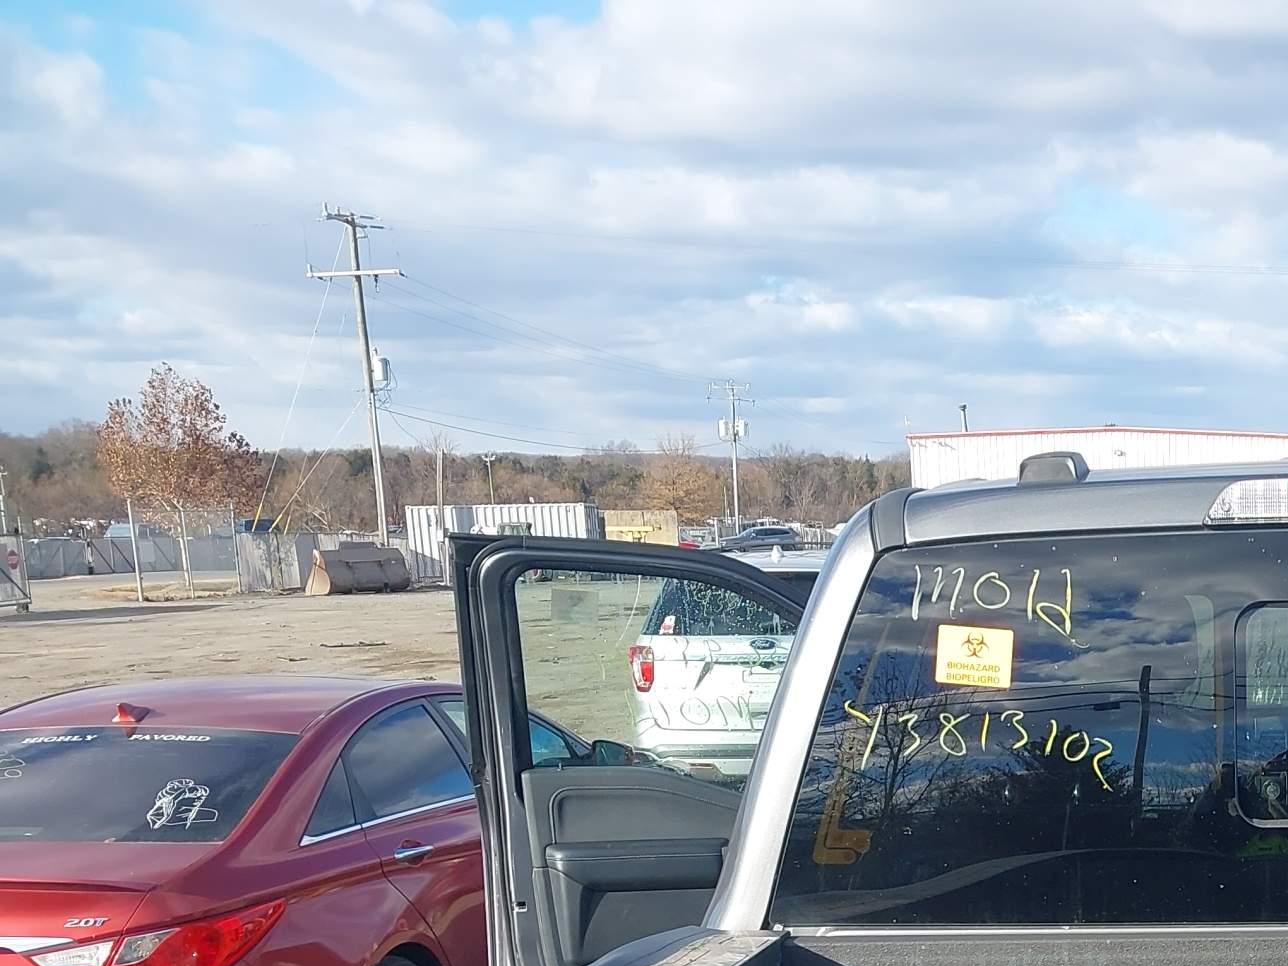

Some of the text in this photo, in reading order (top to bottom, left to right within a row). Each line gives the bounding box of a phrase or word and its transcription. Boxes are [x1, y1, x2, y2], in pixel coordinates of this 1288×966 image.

[946, 661, 1001, 673] BIOHAZARD
[945, 672, 1001, 684] BIOPELIGRO
[21, 734, 211, 744] HIGHLY FAVORED
